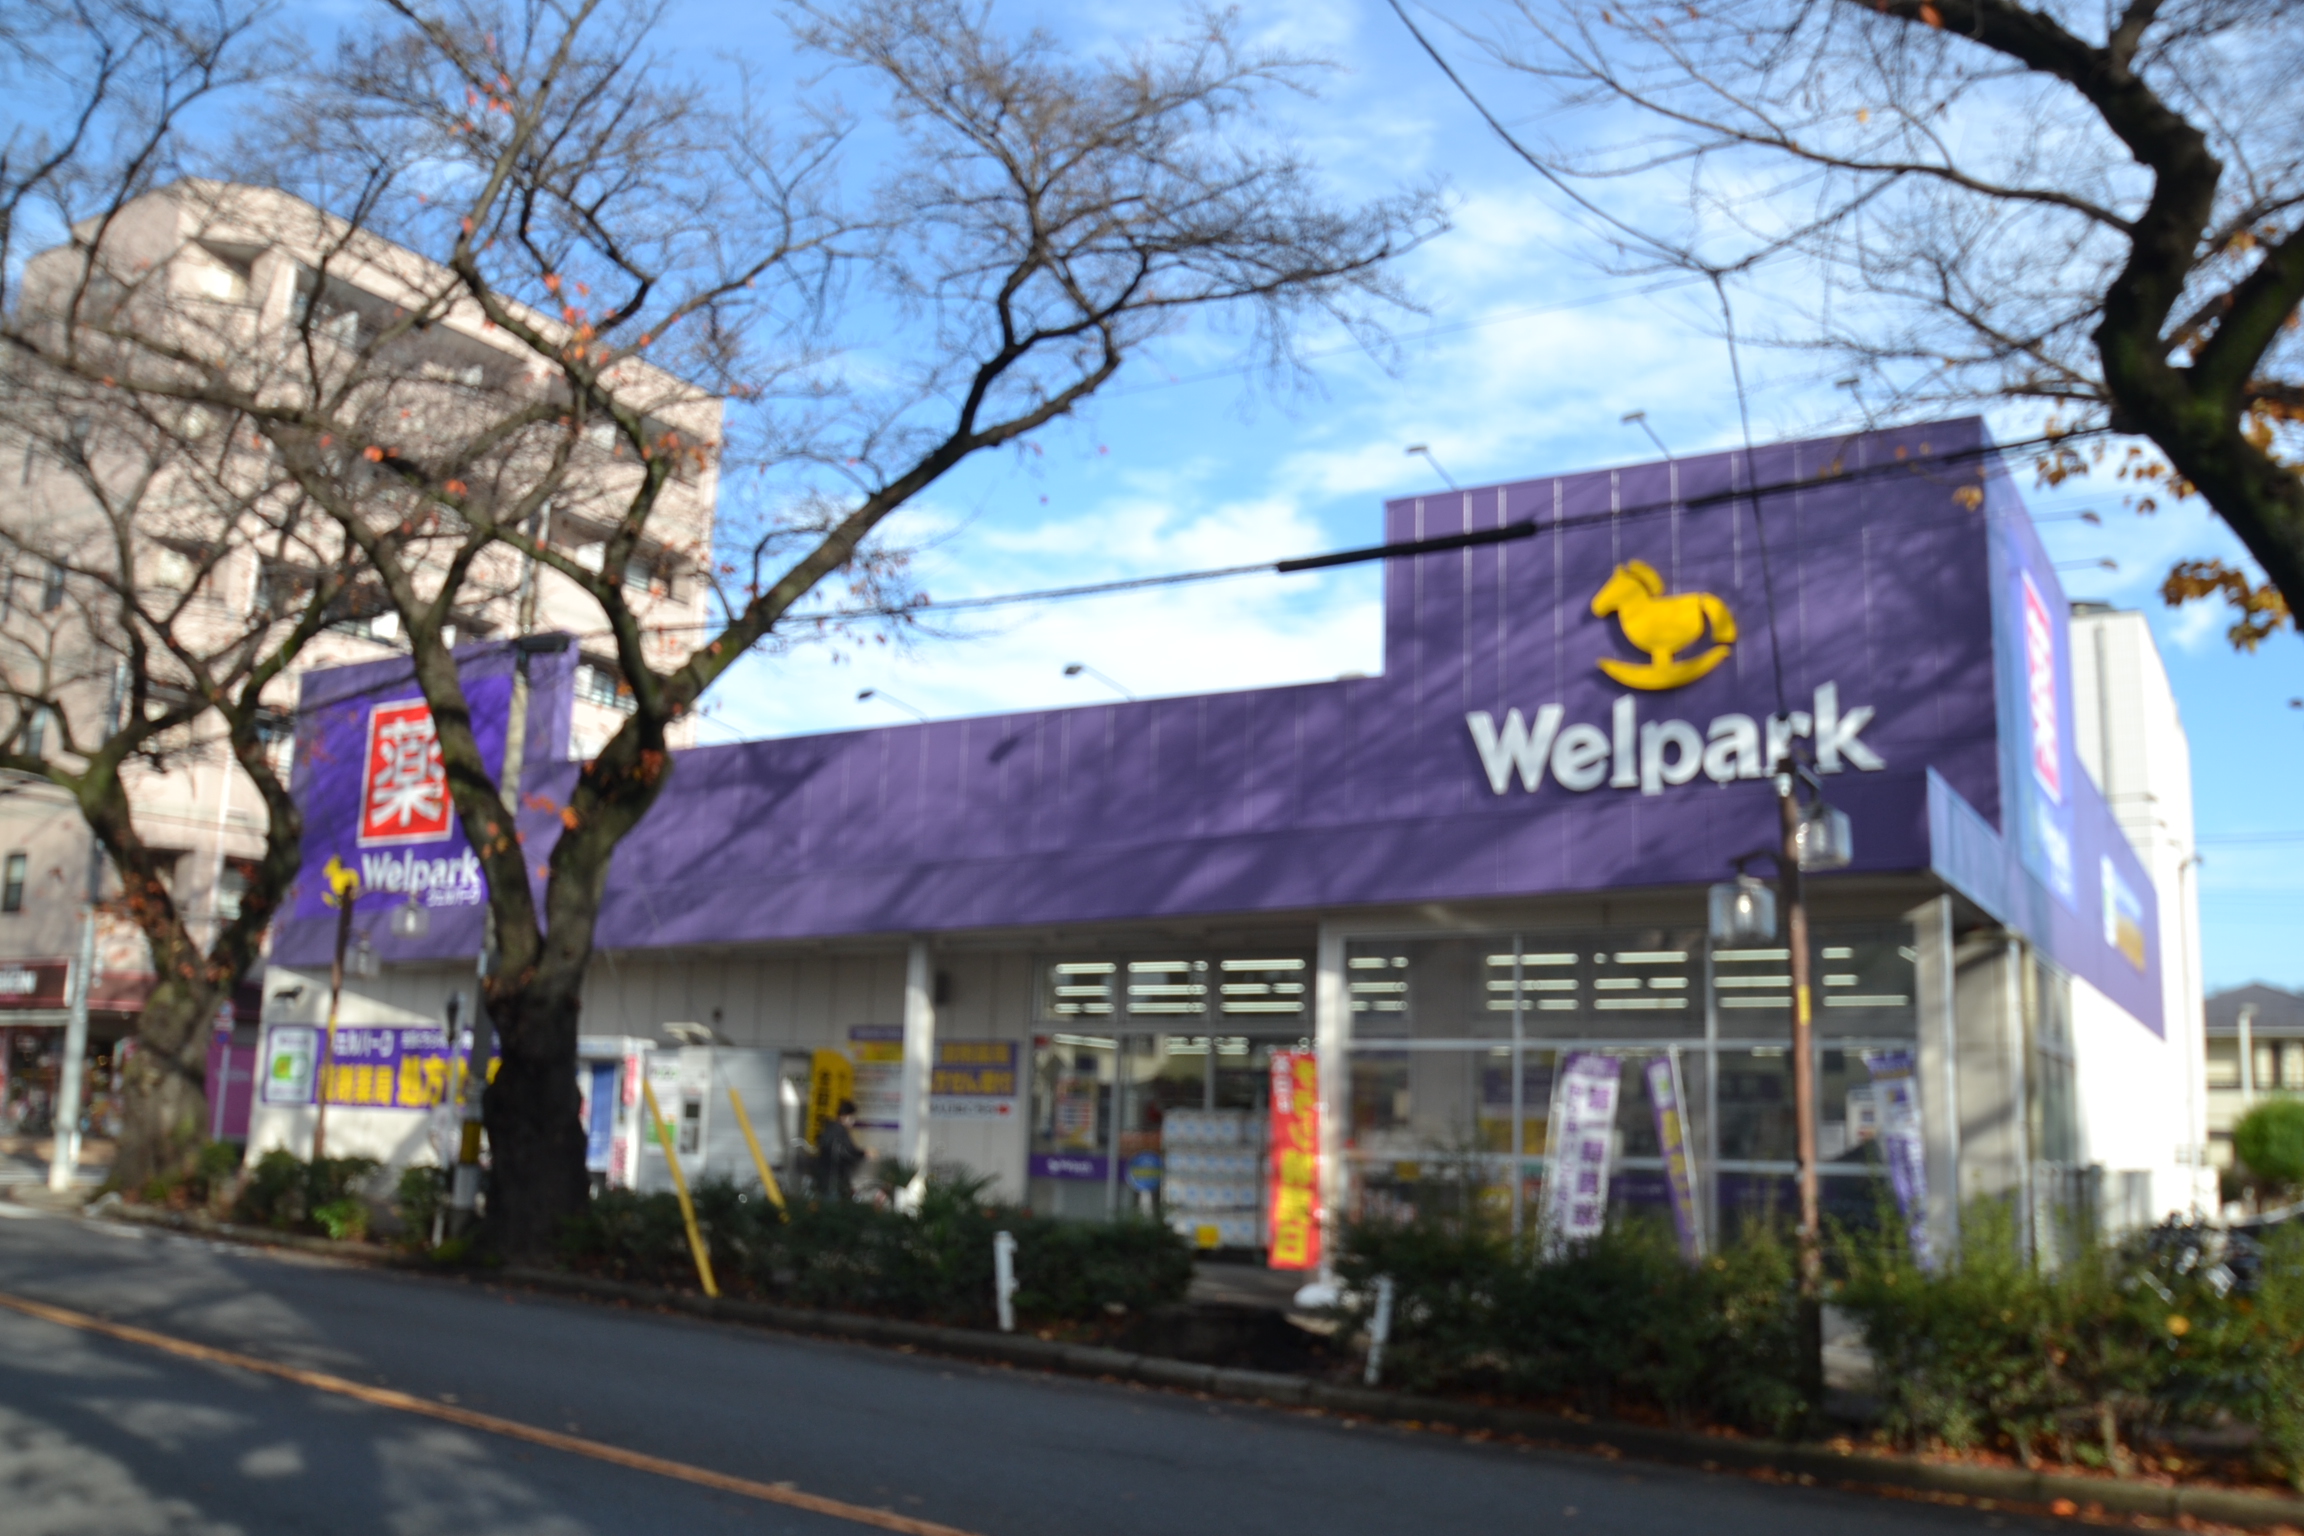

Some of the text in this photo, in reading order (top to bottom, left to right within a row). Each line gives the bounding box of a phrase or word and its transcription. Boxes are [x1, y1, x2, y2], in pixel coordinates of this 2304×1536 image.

[370, 713, 446, 828] 薬
[1466, 681, 1885, 796] Welpark
[361, 846, 481, 894] Welpark
